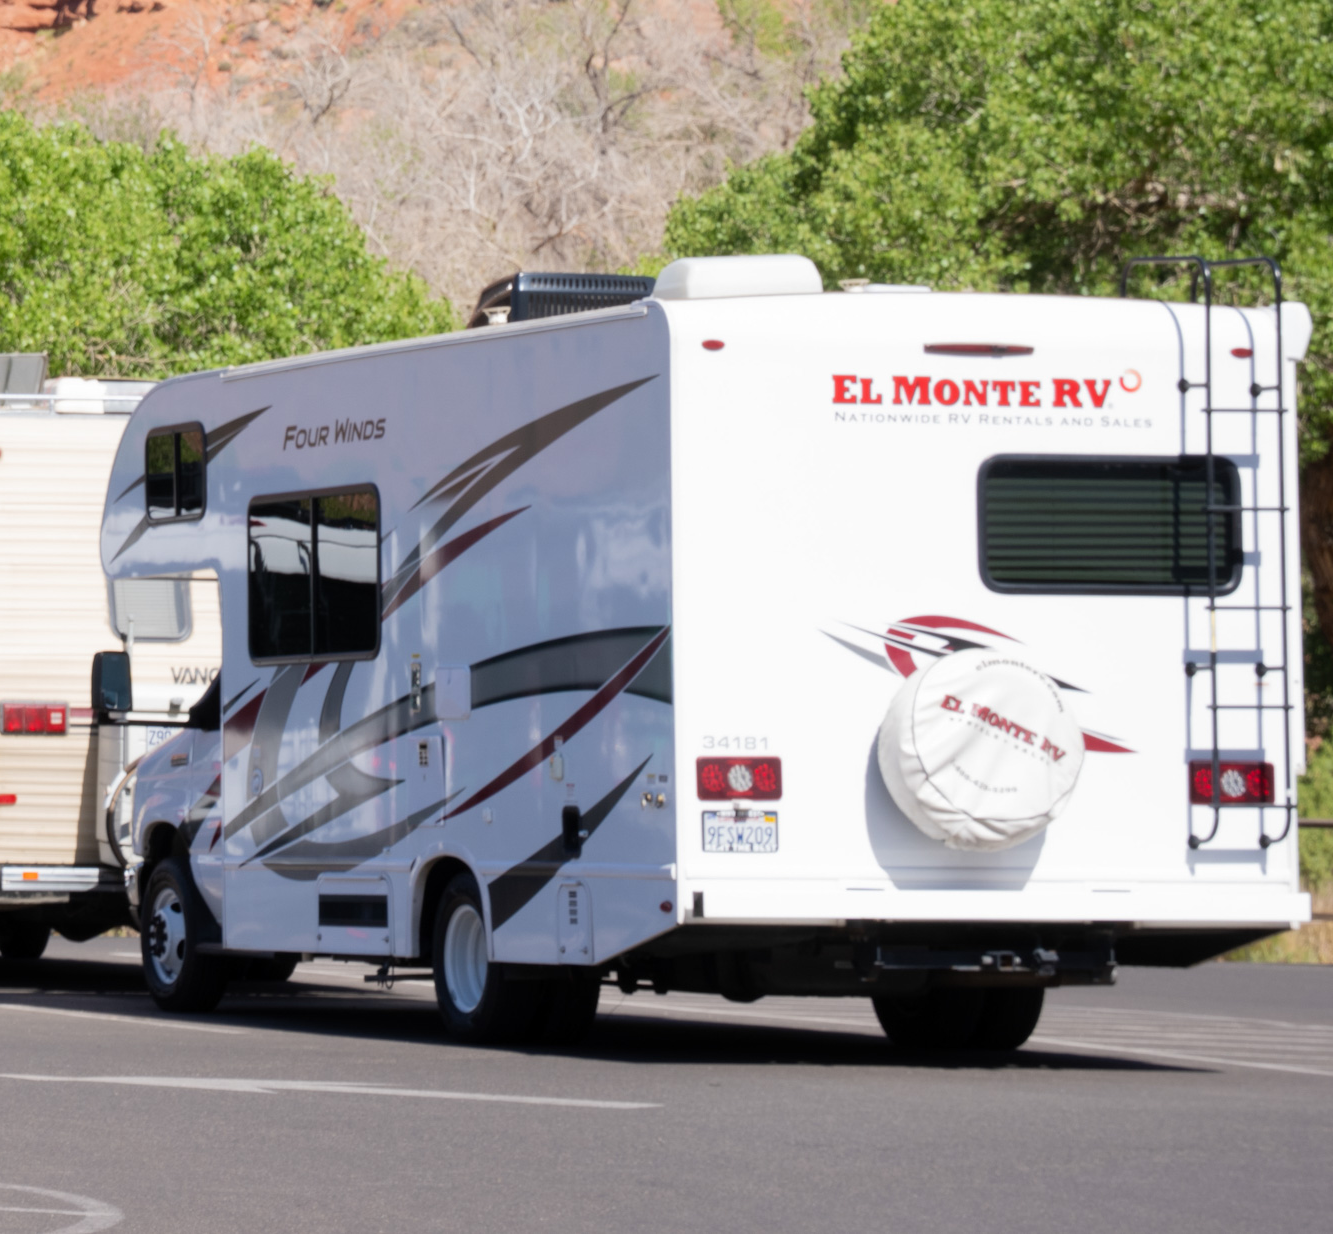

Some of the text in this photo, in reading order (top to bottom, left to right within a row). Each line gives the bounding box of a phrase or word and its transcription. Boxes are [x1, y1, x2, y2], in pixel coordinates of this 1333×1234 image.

[831, 374, 1112, 408] EL MONTE RV
[282, 417, 387, 452] FOUR WINDS
[834, 411, 1153, 429] NATIONWIDE RV RENTALS AND SALES
[702, 735, 769, 750] 34181
[940, 694, 1067, 763] EL MONTE RV
